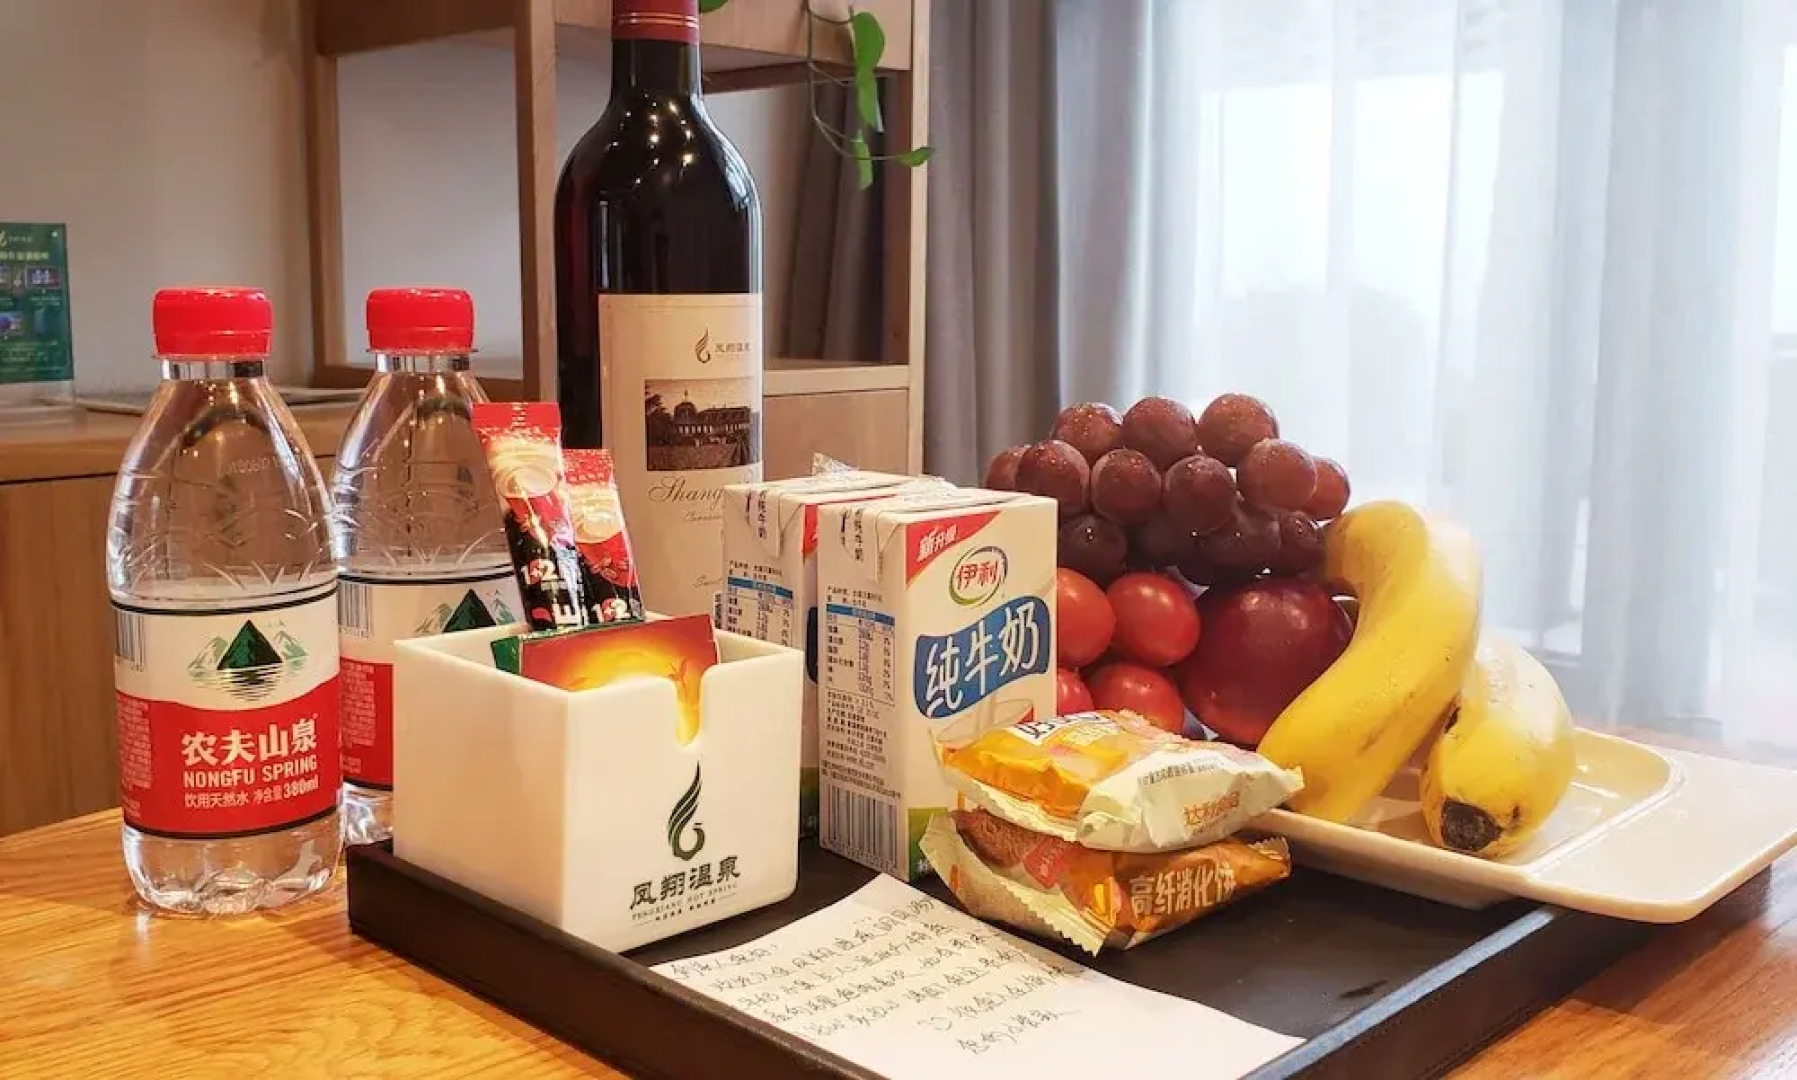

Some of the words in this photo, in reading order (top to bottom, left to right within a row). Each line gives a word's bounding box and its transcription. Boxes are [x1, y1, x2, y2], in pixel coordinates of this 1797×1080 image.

[521, 559, 559, 585] 1+2
[956, 559, 999, 589] 伊利
[592, 598, 632, 622] 1+2
[924, 601, 1041, 716] 纯牛奶
[180, 718, 317, 766] 农夫山泉
[183, 768, 255, 788] NONGFU
[262, 754, 317, 782] SPRING
[184, 790, 249, 809] 饮用天然水
[629, 855, 741, 910] 凤翔温泉
[1129, 861, 1237, 917] 高纤消化饼
